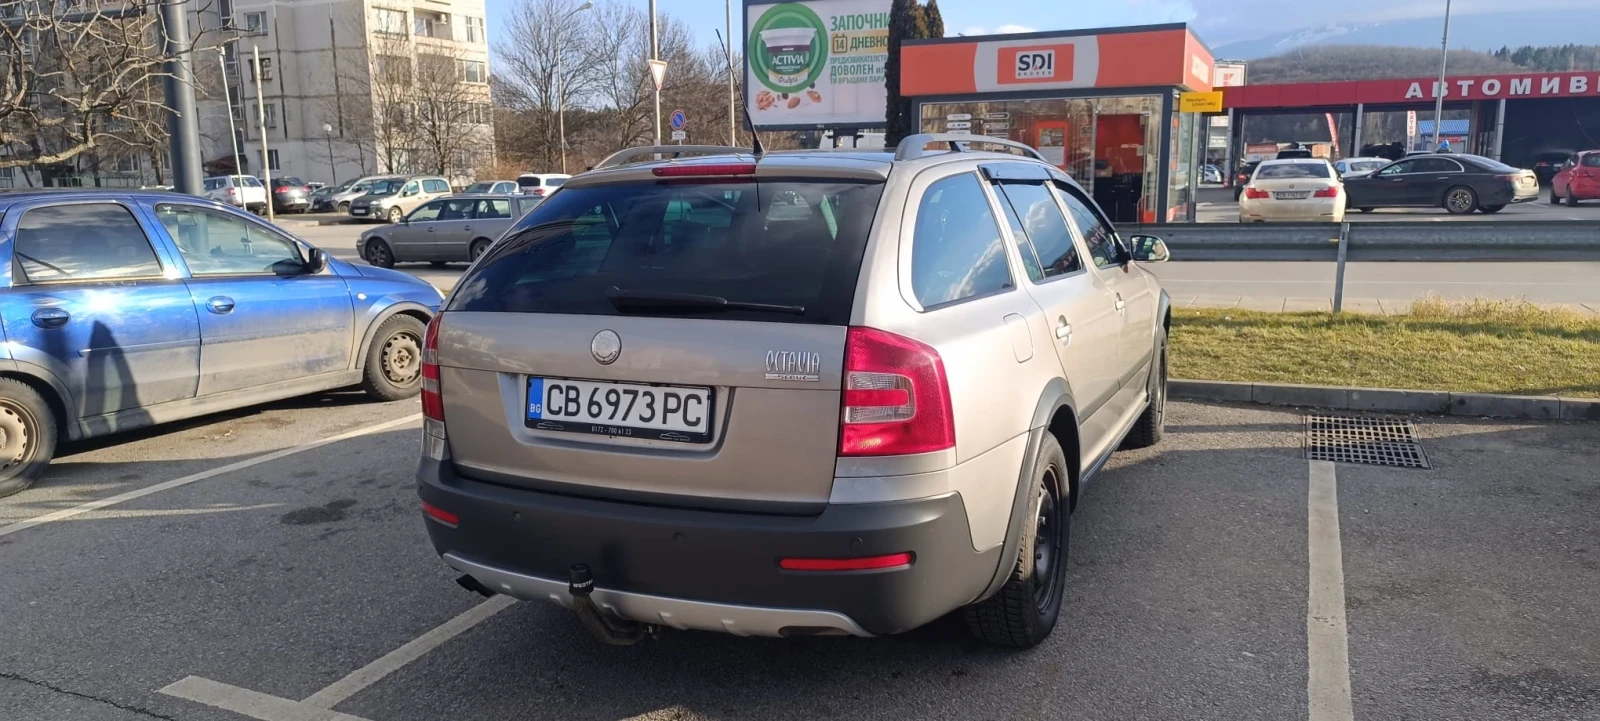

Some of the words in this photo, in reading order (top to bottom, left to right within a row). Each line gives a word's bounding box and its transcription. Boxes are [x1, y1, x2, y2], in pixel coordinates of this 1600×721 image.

[835, 39, 845, 50] 14
[772, 55, 805, 65] ACTIVIA
[1018, 53, 1052, 71] SDI
[830, 64, 874, 76] ДОВОЛЕН
[1405, 76, 1600, 98] АВТОМИВ
[765, 350, 820, 373] OCTAVIA
[530, 404, 541, 413] BG
[546, 384, 581, 416] CB
[587, 387, 656, 423] 6973
[662, 392, 702, 427] PC
